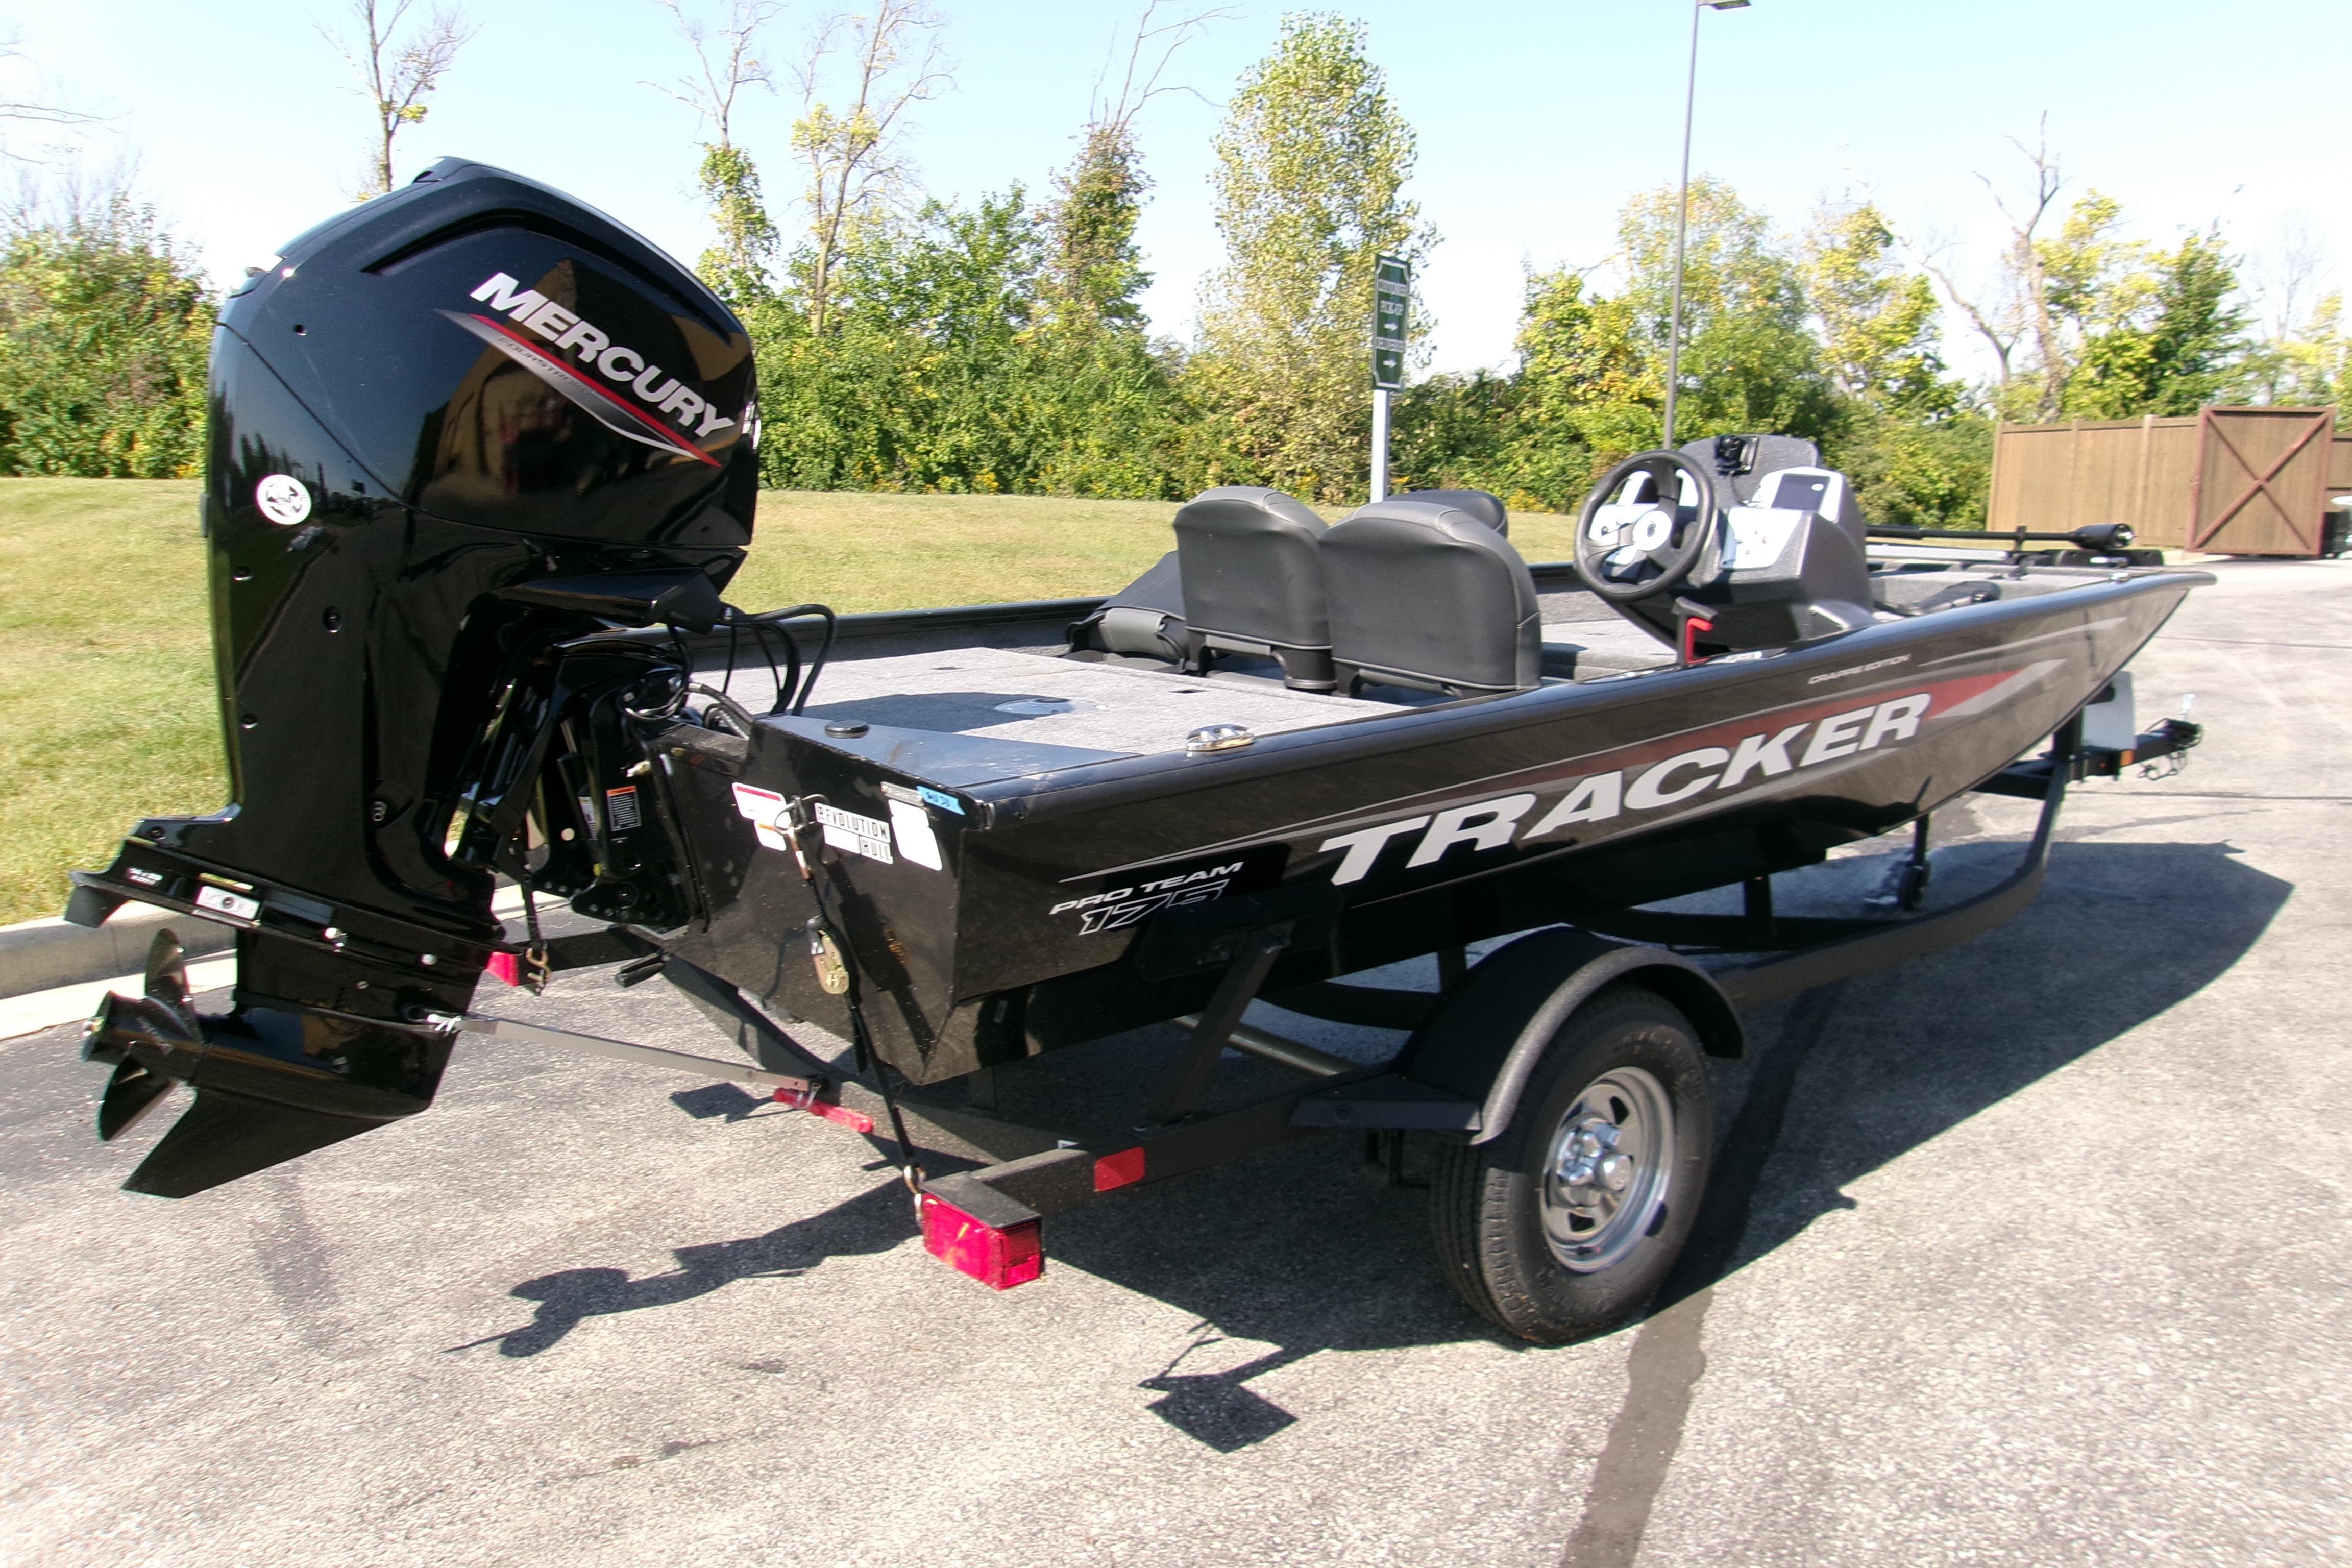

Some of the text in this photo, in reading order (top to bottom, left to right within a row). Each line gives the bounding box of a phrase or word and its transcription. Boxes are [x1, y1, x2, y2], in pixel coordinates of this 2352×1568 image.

[470, 272, 736, 438] MERCURY
[817, 806, 889, 839] REVOLUTION
[1318, 693, 1931, 886] TRACKER
[1049, 862, 1244, 915] PRO TEAM
